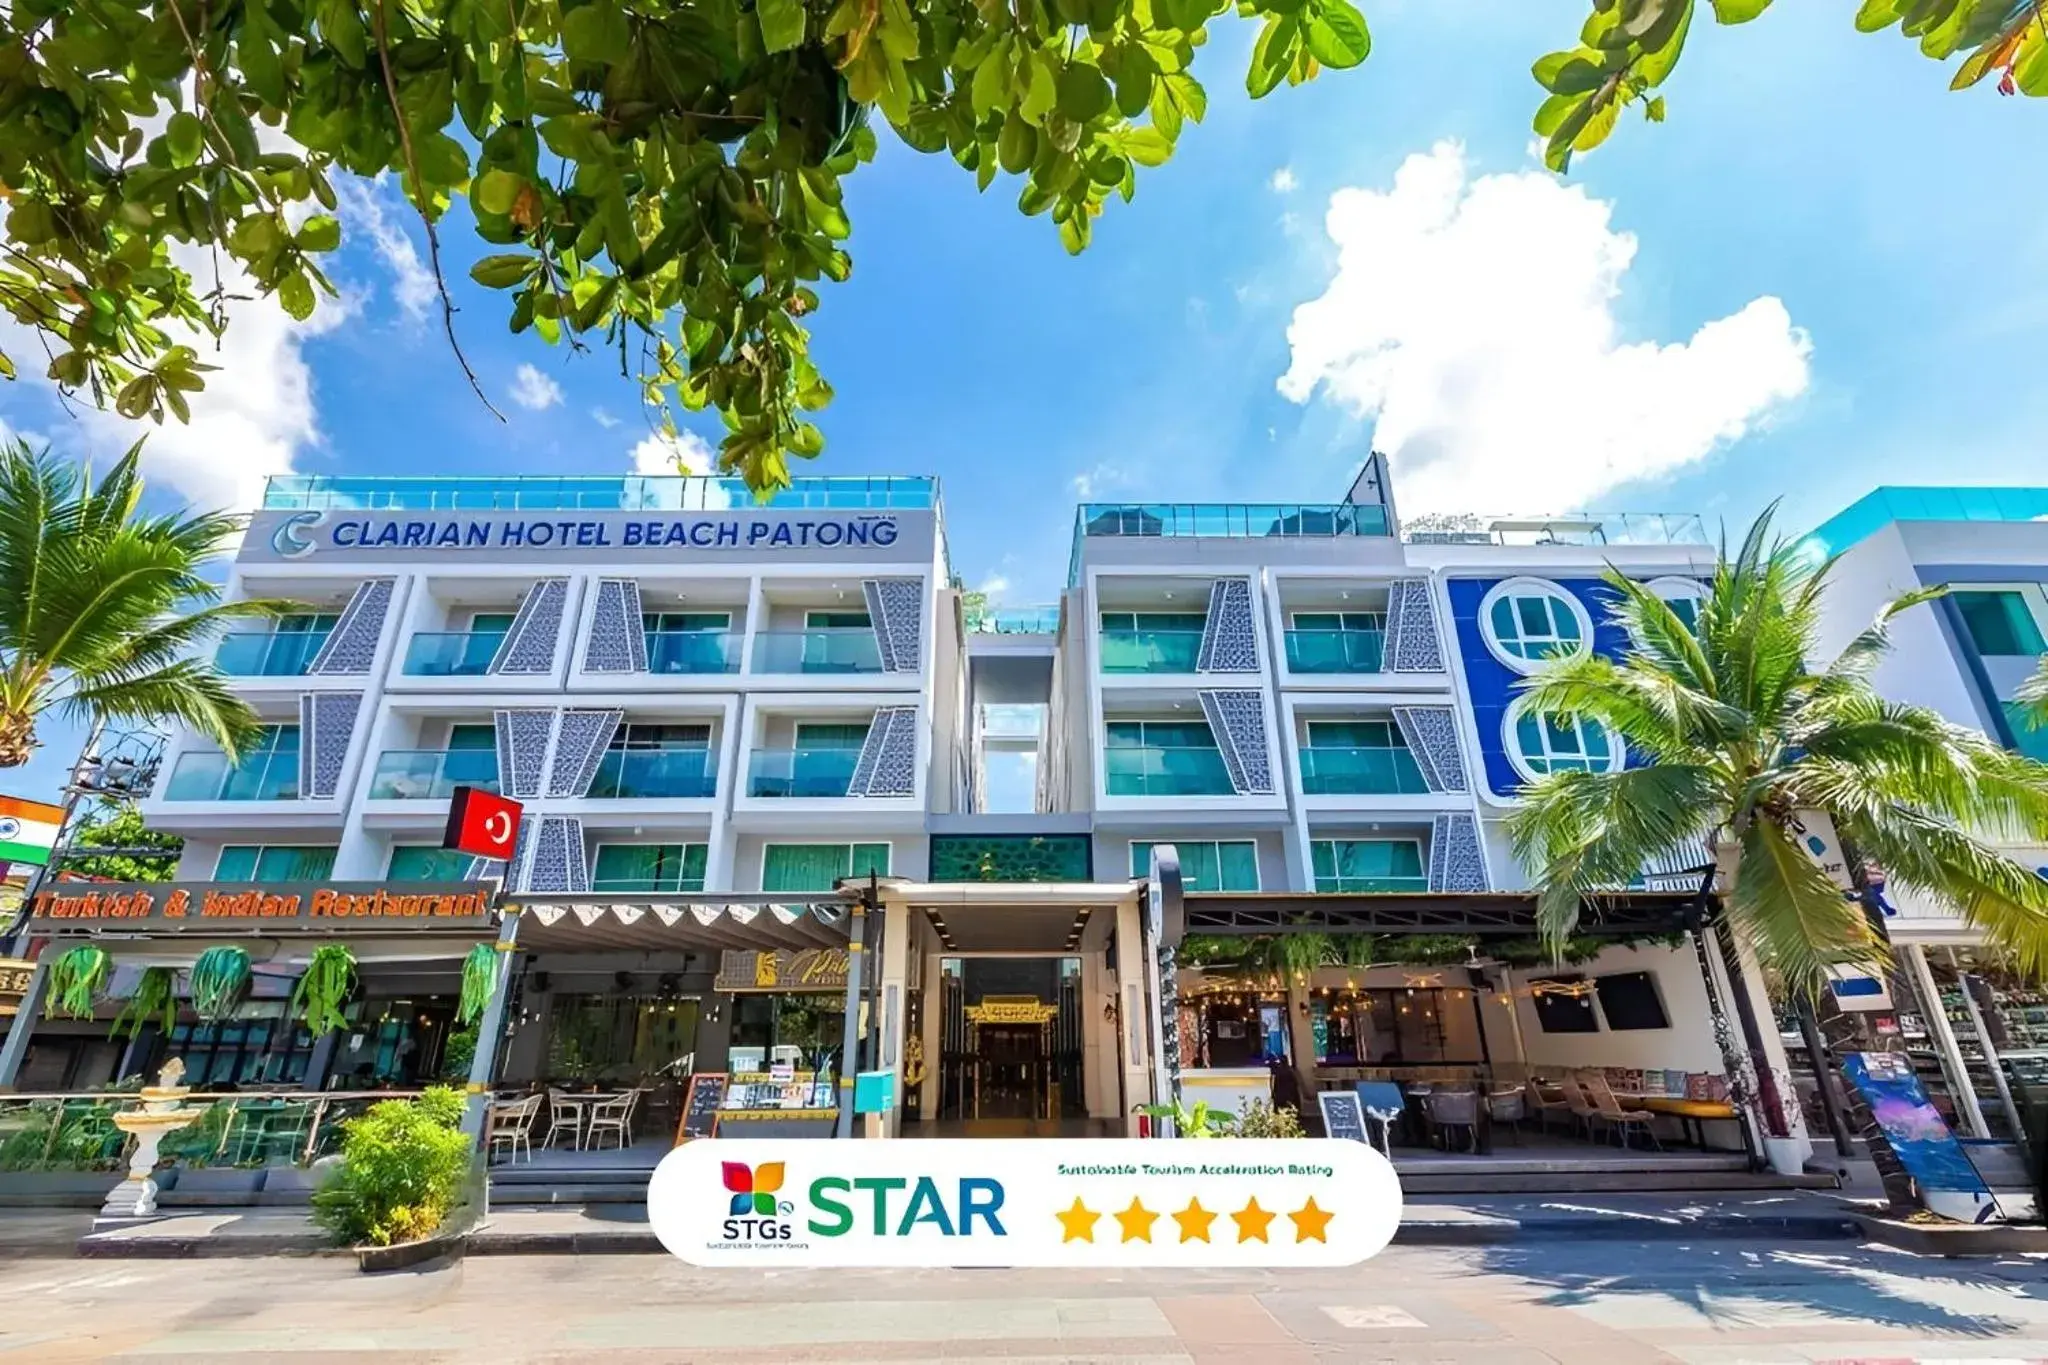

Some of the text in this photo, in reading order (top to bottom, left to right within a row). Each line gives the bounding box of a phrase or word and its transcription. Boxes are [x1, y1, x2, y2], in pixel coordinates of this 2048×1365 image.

[332, 521, 491, 546] CLARIAN
[501, 521, 611, 546] HOTEL
[623, 521, 738, 545] BEACH
[749, 521, 898, 546] PATONG
[32, 888, 487, 918] Turkish & Indian Restaurant
